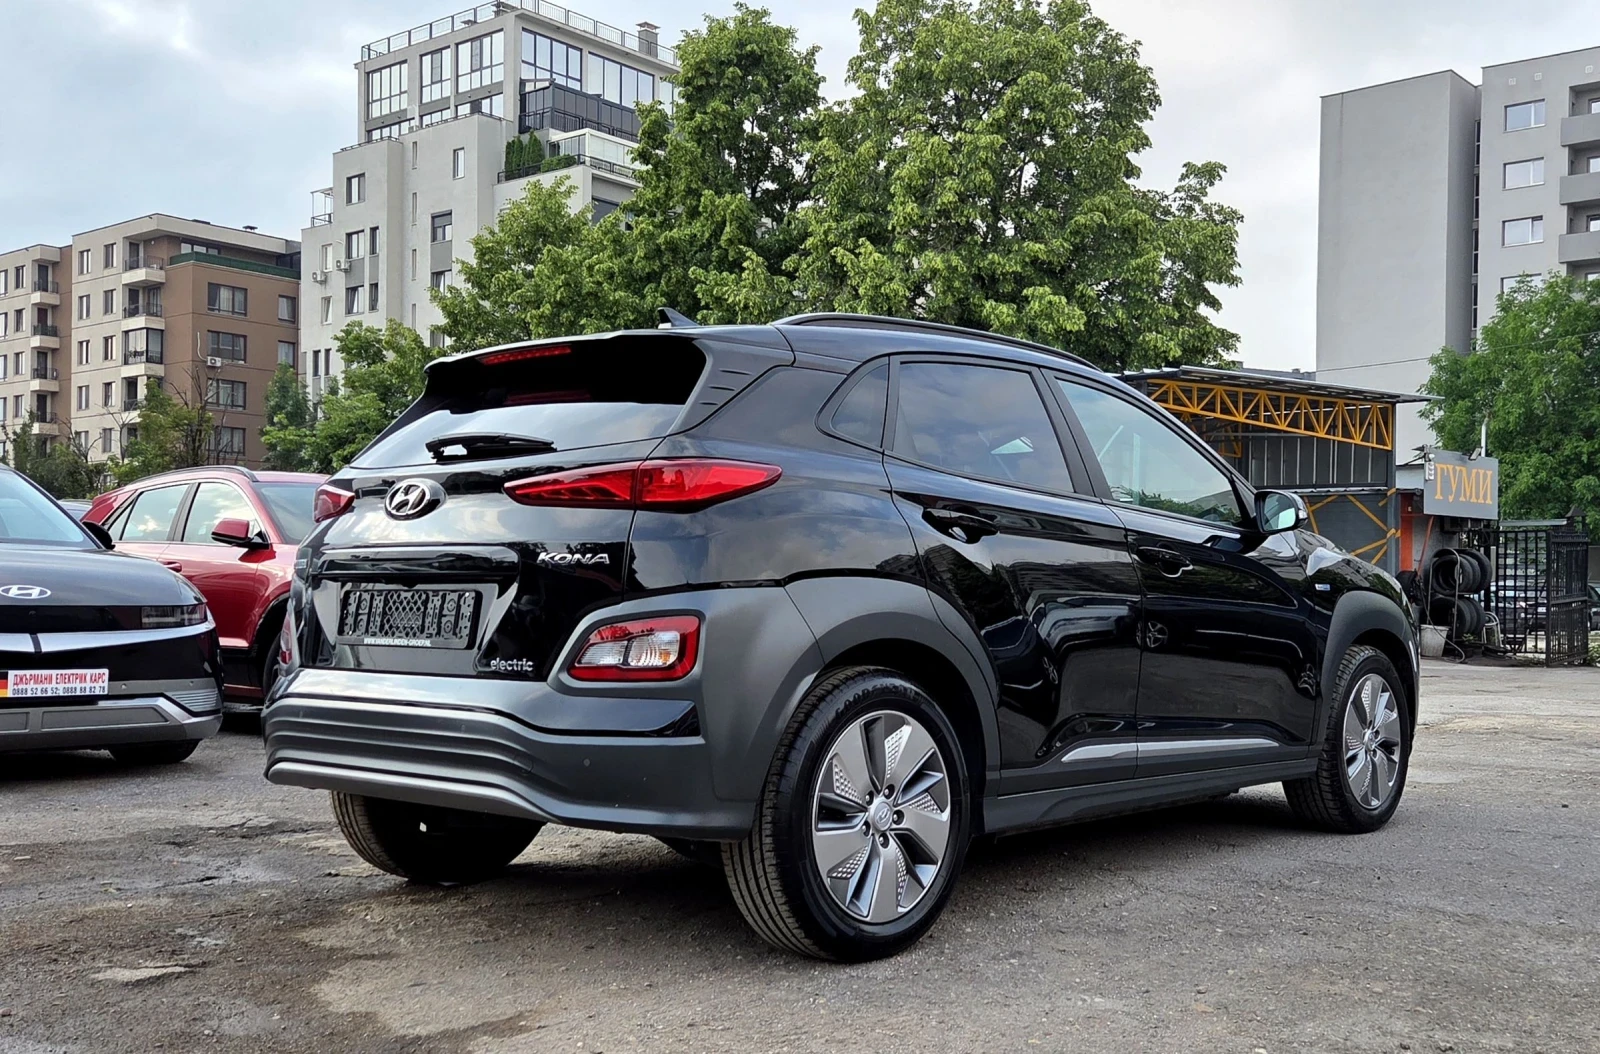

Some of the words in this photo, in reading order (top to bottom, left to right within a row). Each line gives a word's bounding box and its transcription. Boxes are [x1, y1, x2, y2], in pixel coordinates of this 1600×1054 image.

[1434, 463, 1493, 504] ГУМИ
[536, 551, 610, 564] KONA
[490, 657, 534, 672] electric
[13, 673, 53, 687] ДЖЪРМАНИ
[55, 673, 87, 685] ЕЛЕКТРИК
[89, 672, 106, 684] КАРС
[12, 687, 28, 696] 0888
[30, 687, 39, 695] 52
[40, 687, 49, 695] 66
[62, 686, 78, 695] 0888
[88, 686, 97, 694] 82
[98, 685, 106, 694] 78
